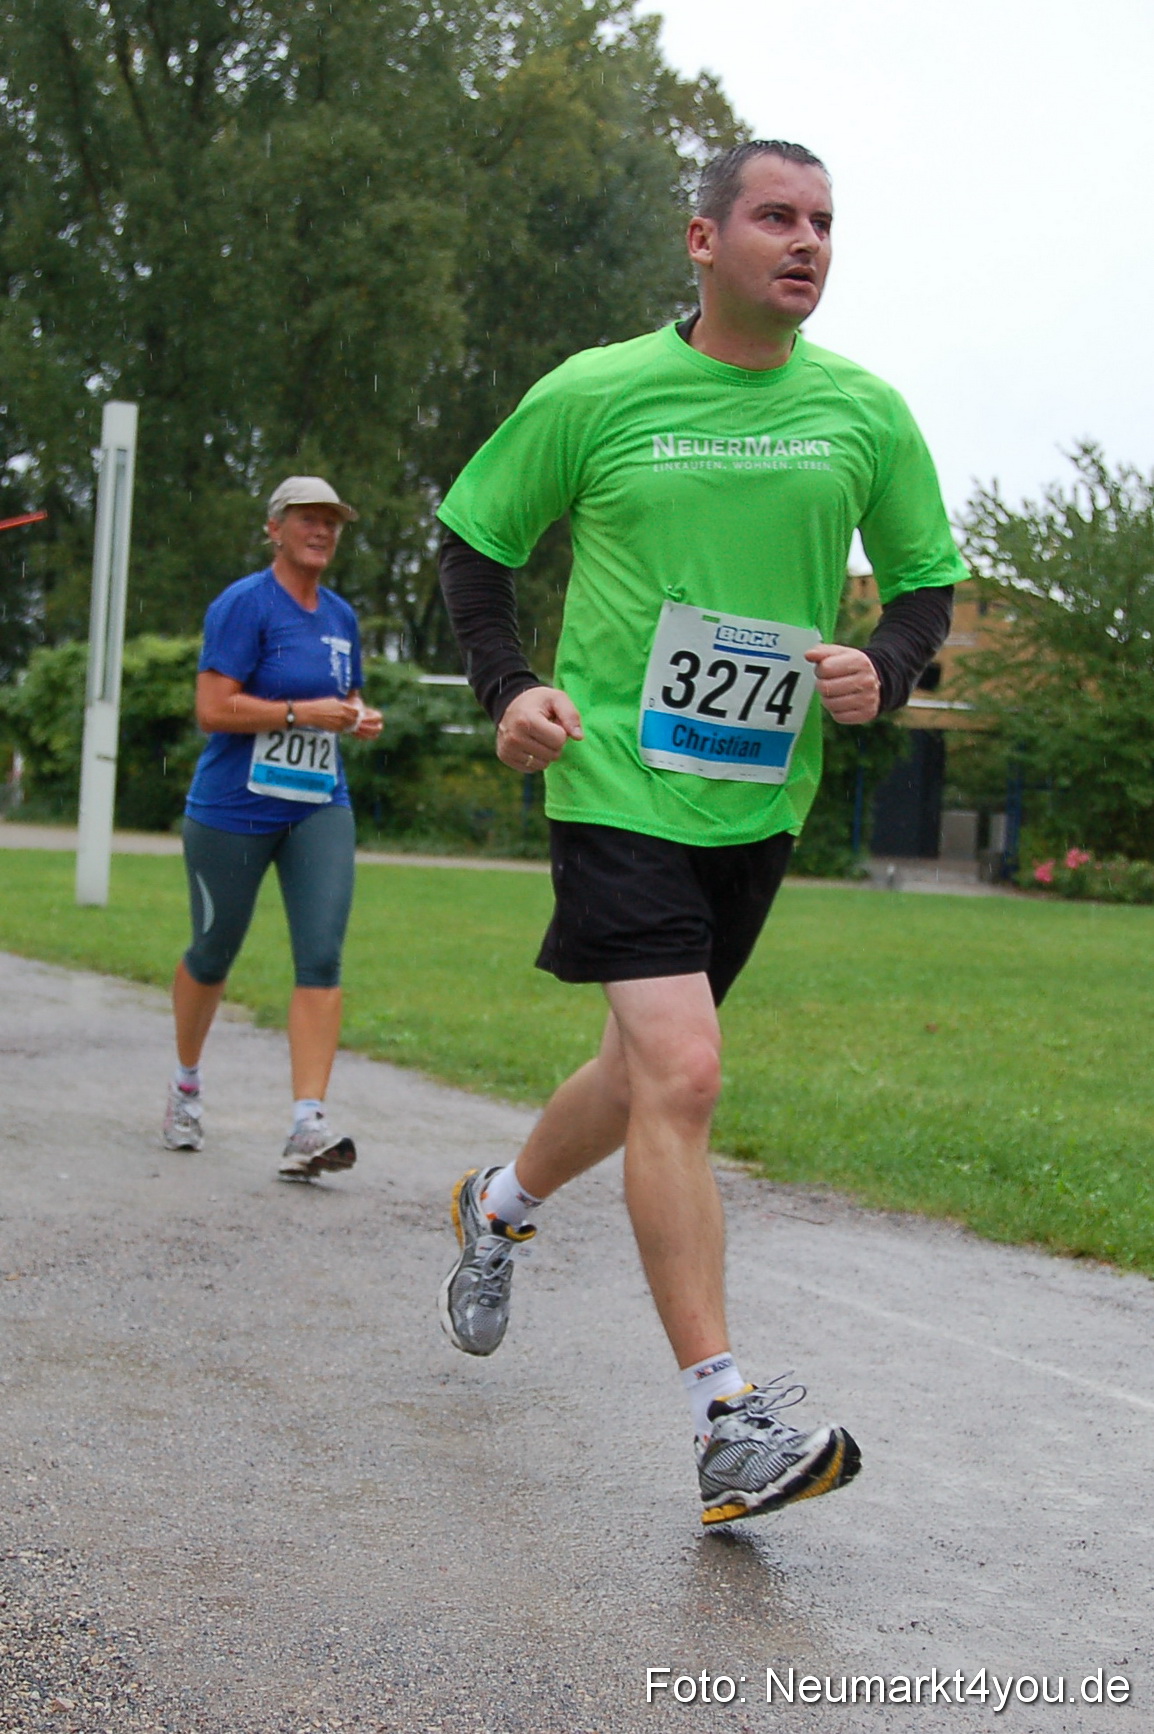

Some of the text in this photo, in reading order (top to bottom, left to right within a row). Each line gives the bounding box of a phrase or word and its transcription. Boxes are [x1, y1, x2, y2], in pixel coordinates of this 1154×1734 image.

[731, 461, 793, 471] WOHNEN.
[716, 625, 779, 648] BOCK
[661, 650, 801, 725] 3274
[264, 731, 331, 769] 2012
[672, 724, 762, 758] Christian
